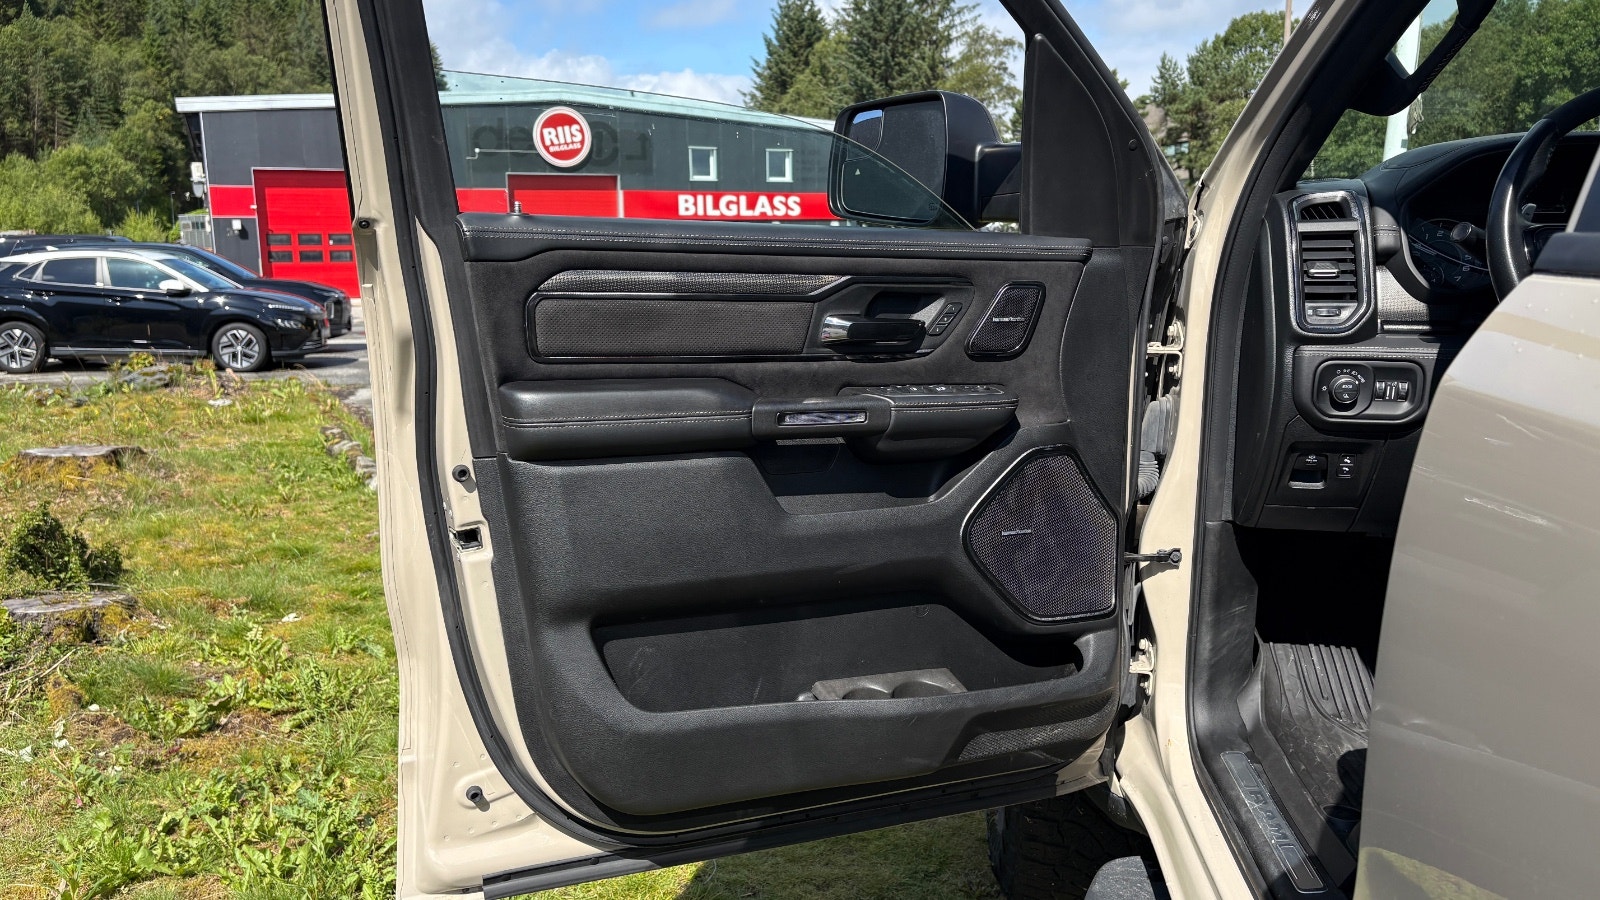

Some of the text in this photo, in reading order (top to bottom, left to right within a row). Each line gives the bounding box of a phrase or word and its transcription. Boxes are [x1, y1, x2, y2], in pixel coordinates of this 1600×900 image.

[542, 123, 583, 147] RIIS
[548, 142, 582, 153] BILGLASS
[677, 194, 802, 217] BILGLASS
